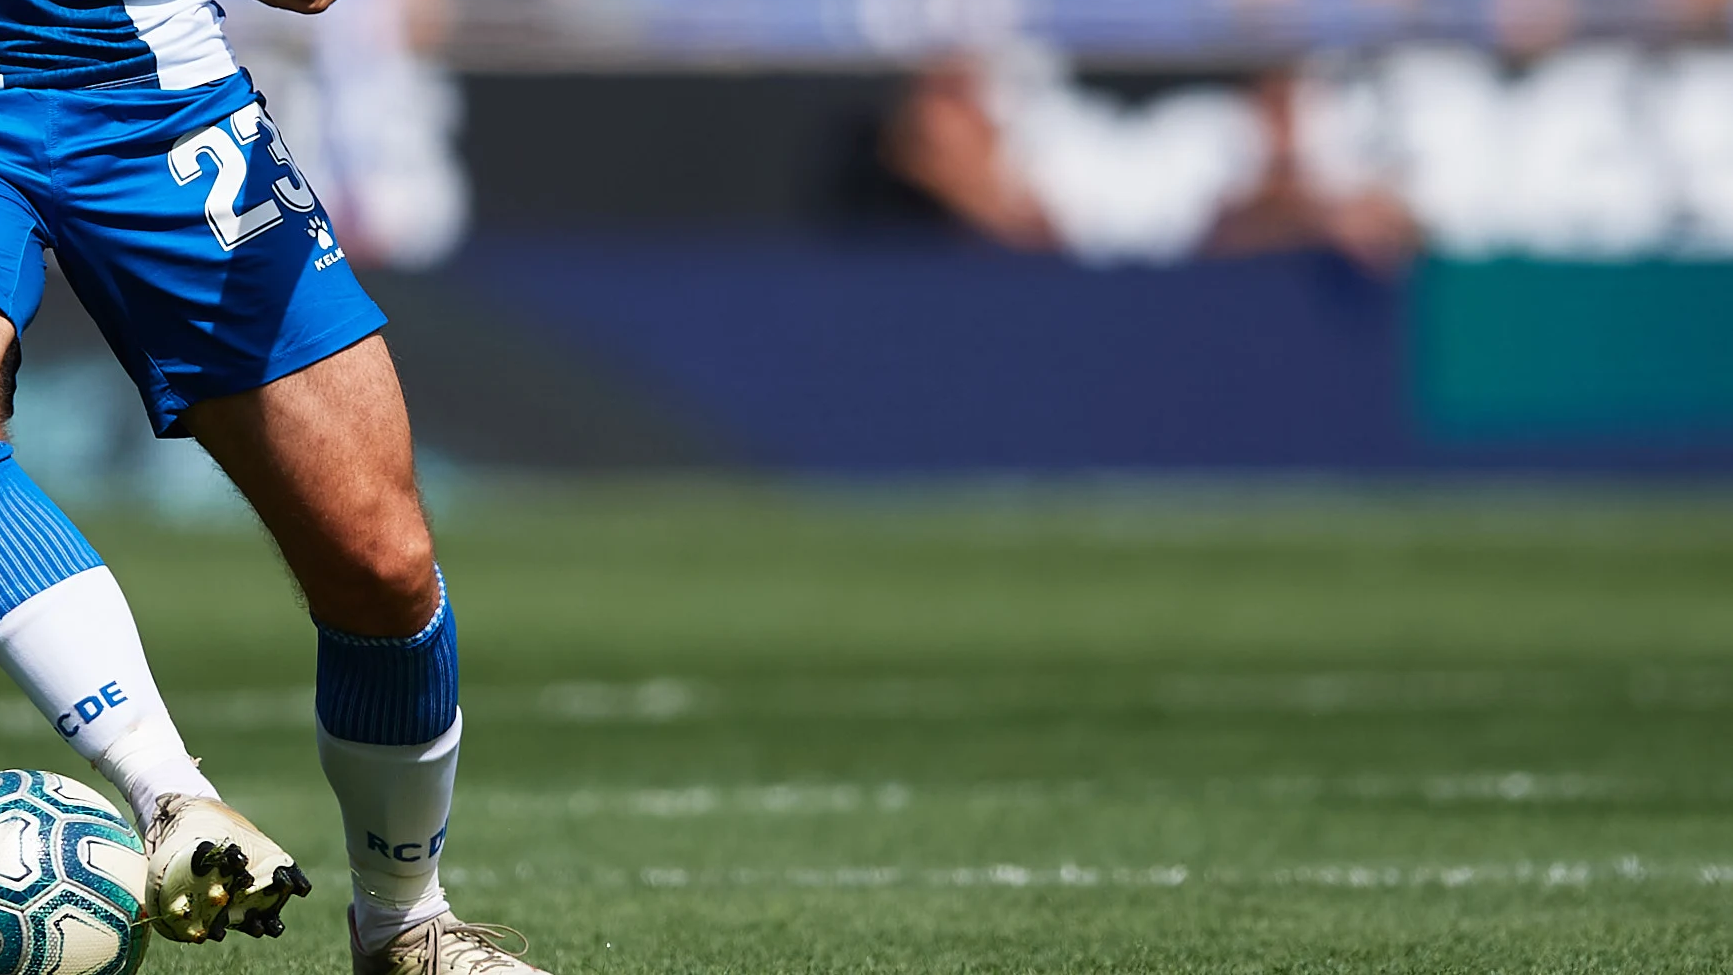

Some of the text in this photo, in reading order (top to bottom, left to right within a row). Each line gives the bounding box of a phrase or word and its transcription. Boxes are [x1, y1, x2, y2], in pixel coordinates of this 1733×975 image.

[167, 101, 316, 252] 23
[54, 680, 129, 743] CDE
[366, 818, 449, 862] RCD
